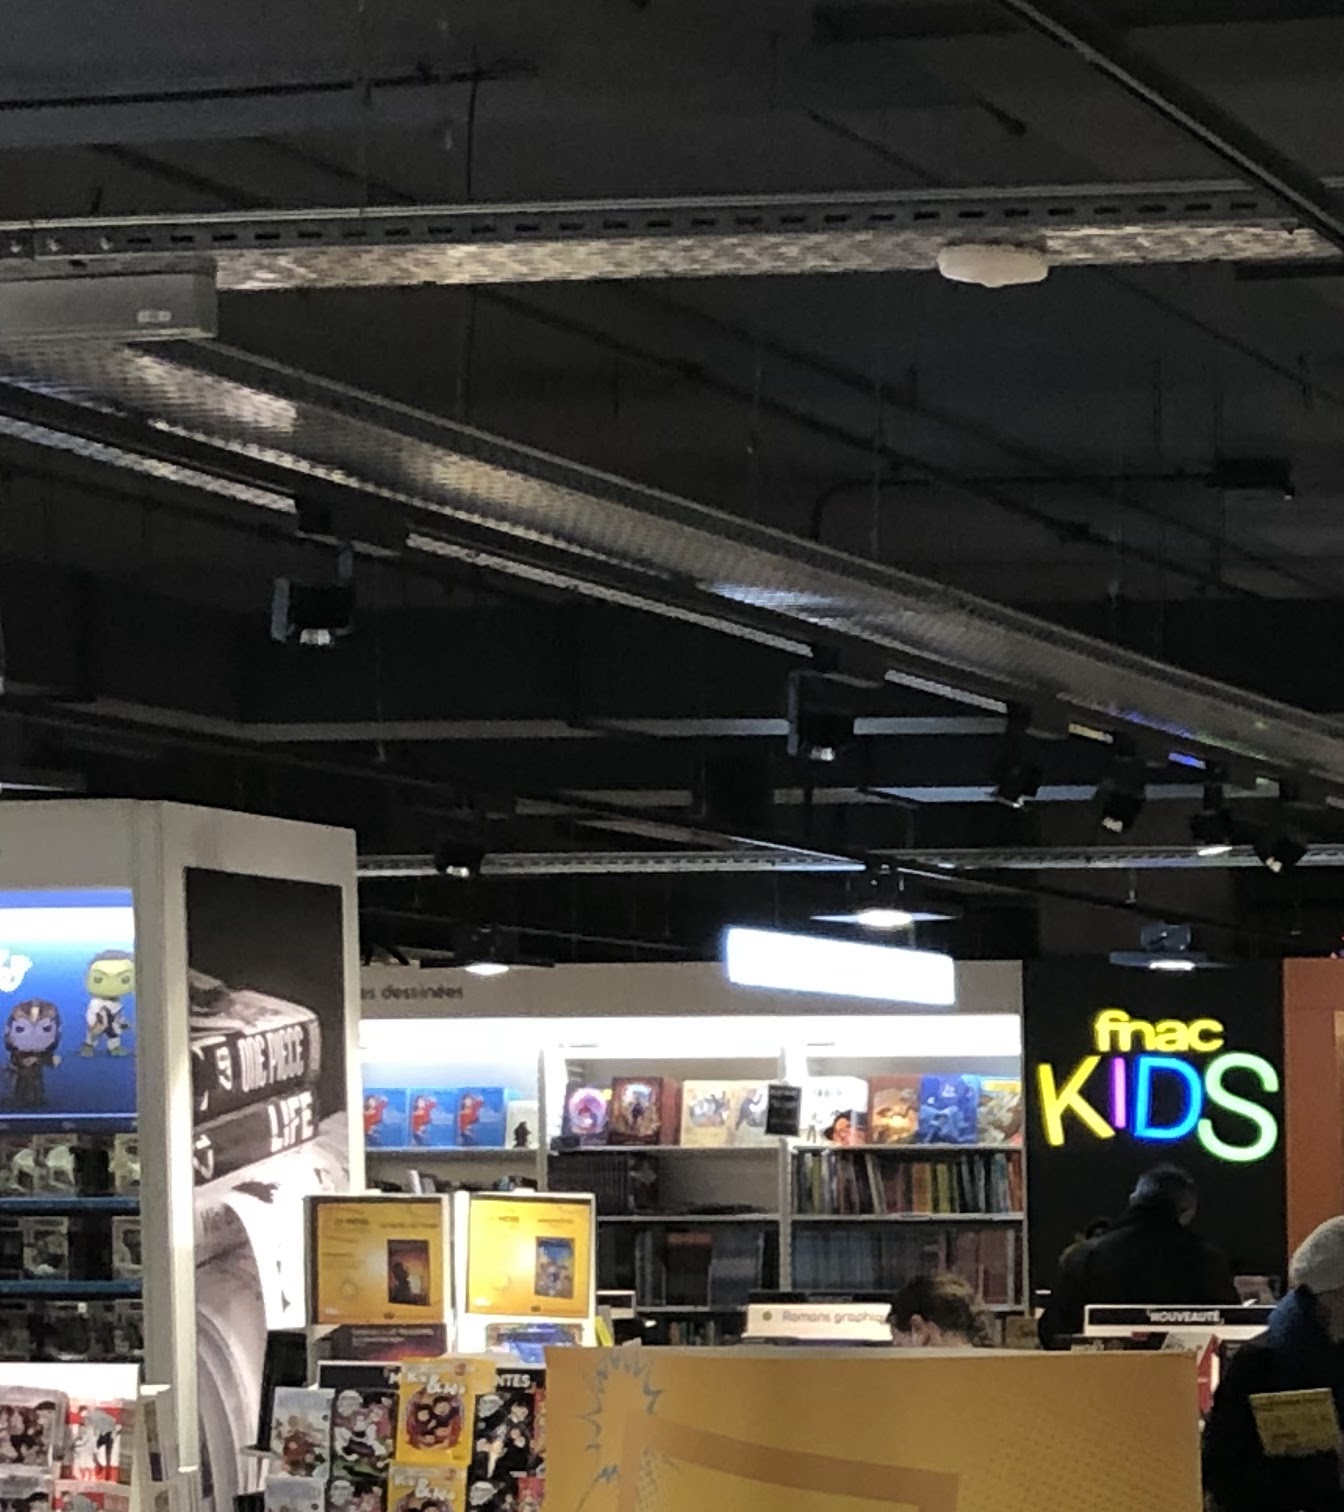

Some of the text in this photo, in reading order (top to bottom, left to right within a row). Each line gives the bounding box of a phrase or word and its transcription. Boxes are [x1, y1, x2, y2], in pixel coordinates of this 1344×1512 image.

[1095, 1010, 1225, 1053] fnac
[269, 1090, 315, 1153] LIFE
[1036, 1052, 1280, 1162] KIDS
